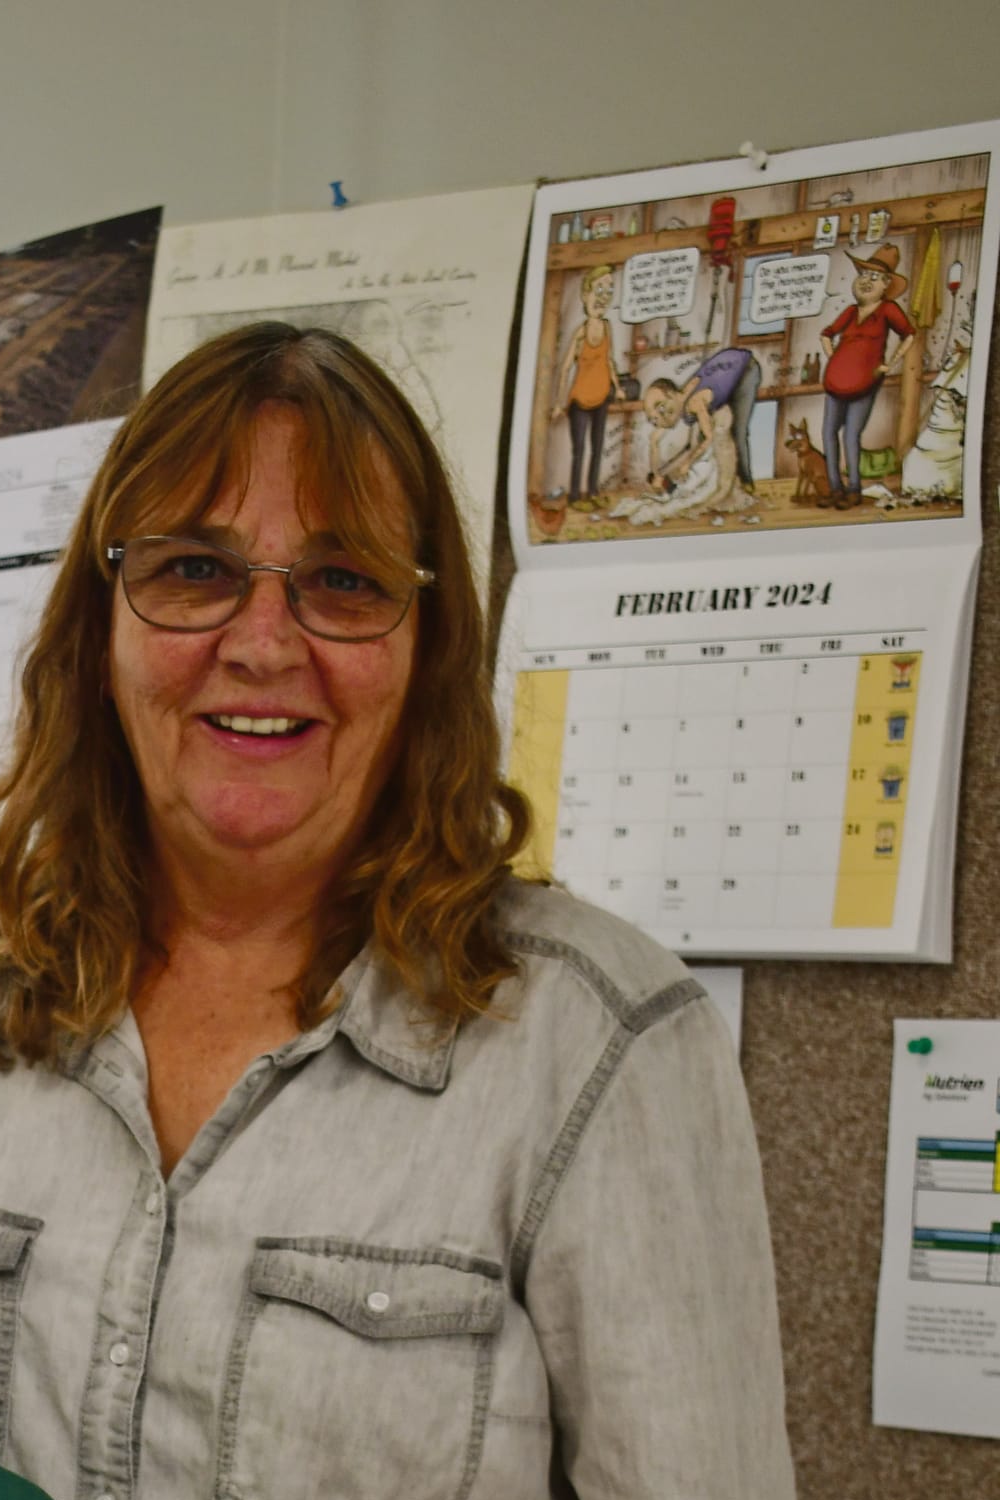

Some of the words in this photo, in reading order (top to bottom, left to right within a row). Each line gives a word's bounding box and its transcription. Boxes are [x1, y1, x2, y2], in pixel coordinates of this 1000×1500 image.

[774, 267, 789, 279] you
[614, 586, 760, 618] FEBRUARY
[765, 582, 833, 609] 2024
[881, 636, 905, 648] SAT
[926, 1073, 985, 1090] Nutrien
